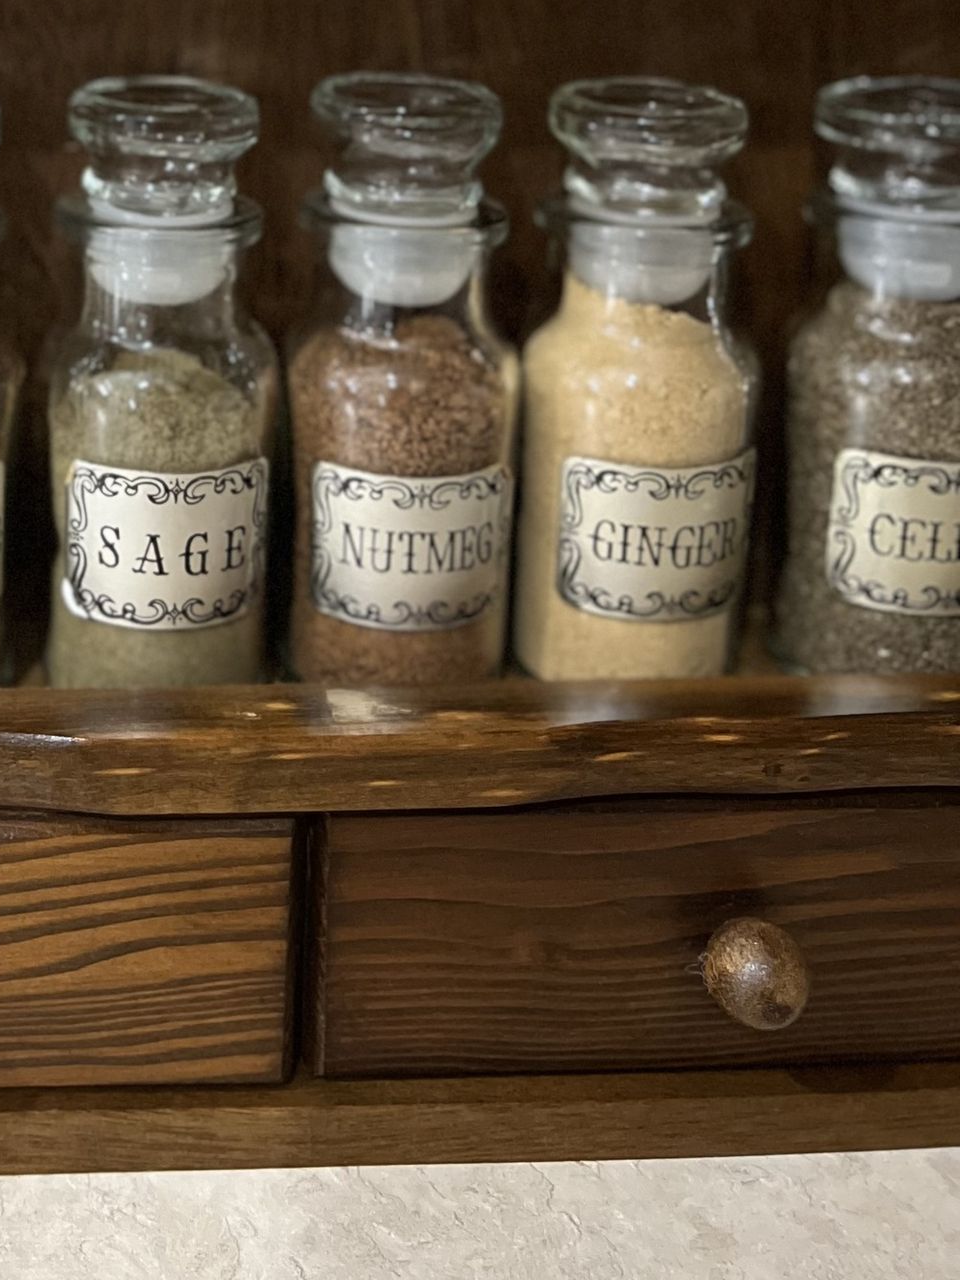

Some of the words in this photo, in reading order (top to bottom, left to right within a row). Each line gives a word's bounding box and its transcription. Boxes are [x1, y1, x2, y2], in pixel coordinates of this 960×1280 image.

[98, 525, 247, 576] SAGE
[340, 521, 494, 575] NUTMEG
[588, 517, 737, 570] GINGER
[867, 512, 960, 564] CEL
